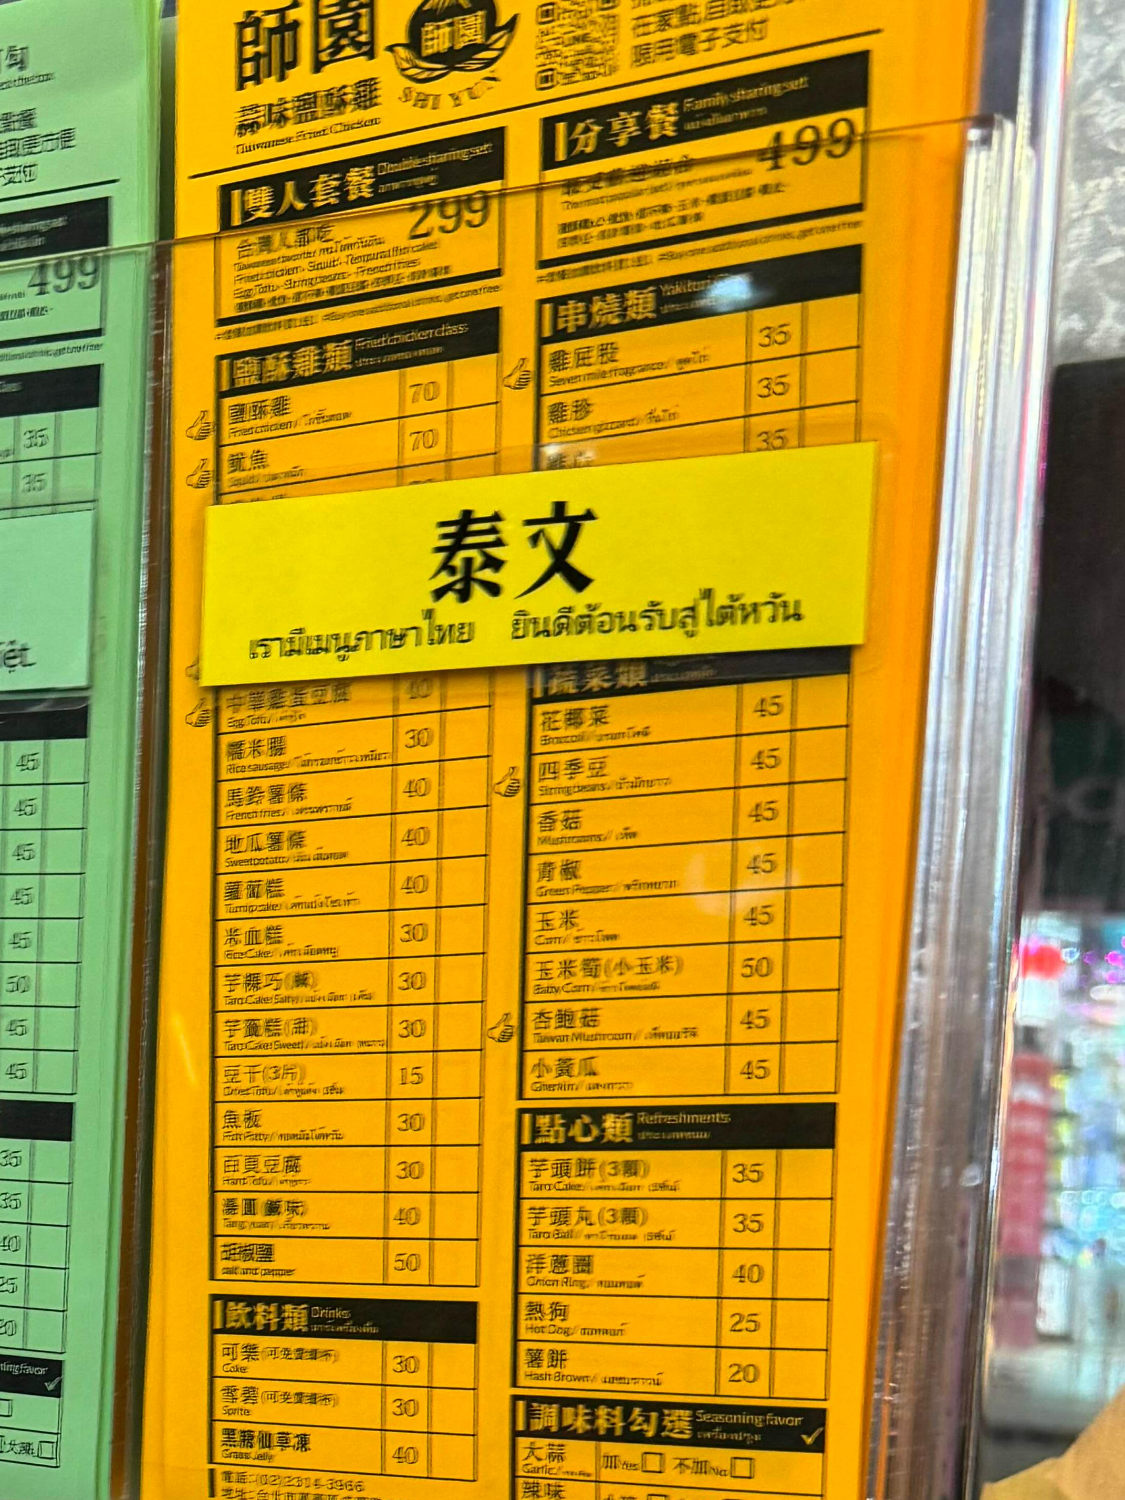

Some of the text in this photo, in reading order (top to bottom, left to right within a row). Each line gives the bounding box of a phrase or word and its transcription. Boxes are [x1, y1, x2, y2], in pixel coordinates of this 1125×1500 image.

[234, 0, 380, 91] 師園
[569, 103, 679, 158] 分享餐
[760, 117, 856, 171] 499
[244, 167, 375, 223] 雙人套餐
[408, 190, 490, 241] 299
[26, 255, 101, 297] 499
[429, 500, 600, 604] 泰文
[536, 910, 581, 933] 玉米
[535, 1113, 634, 1145] 點心類
